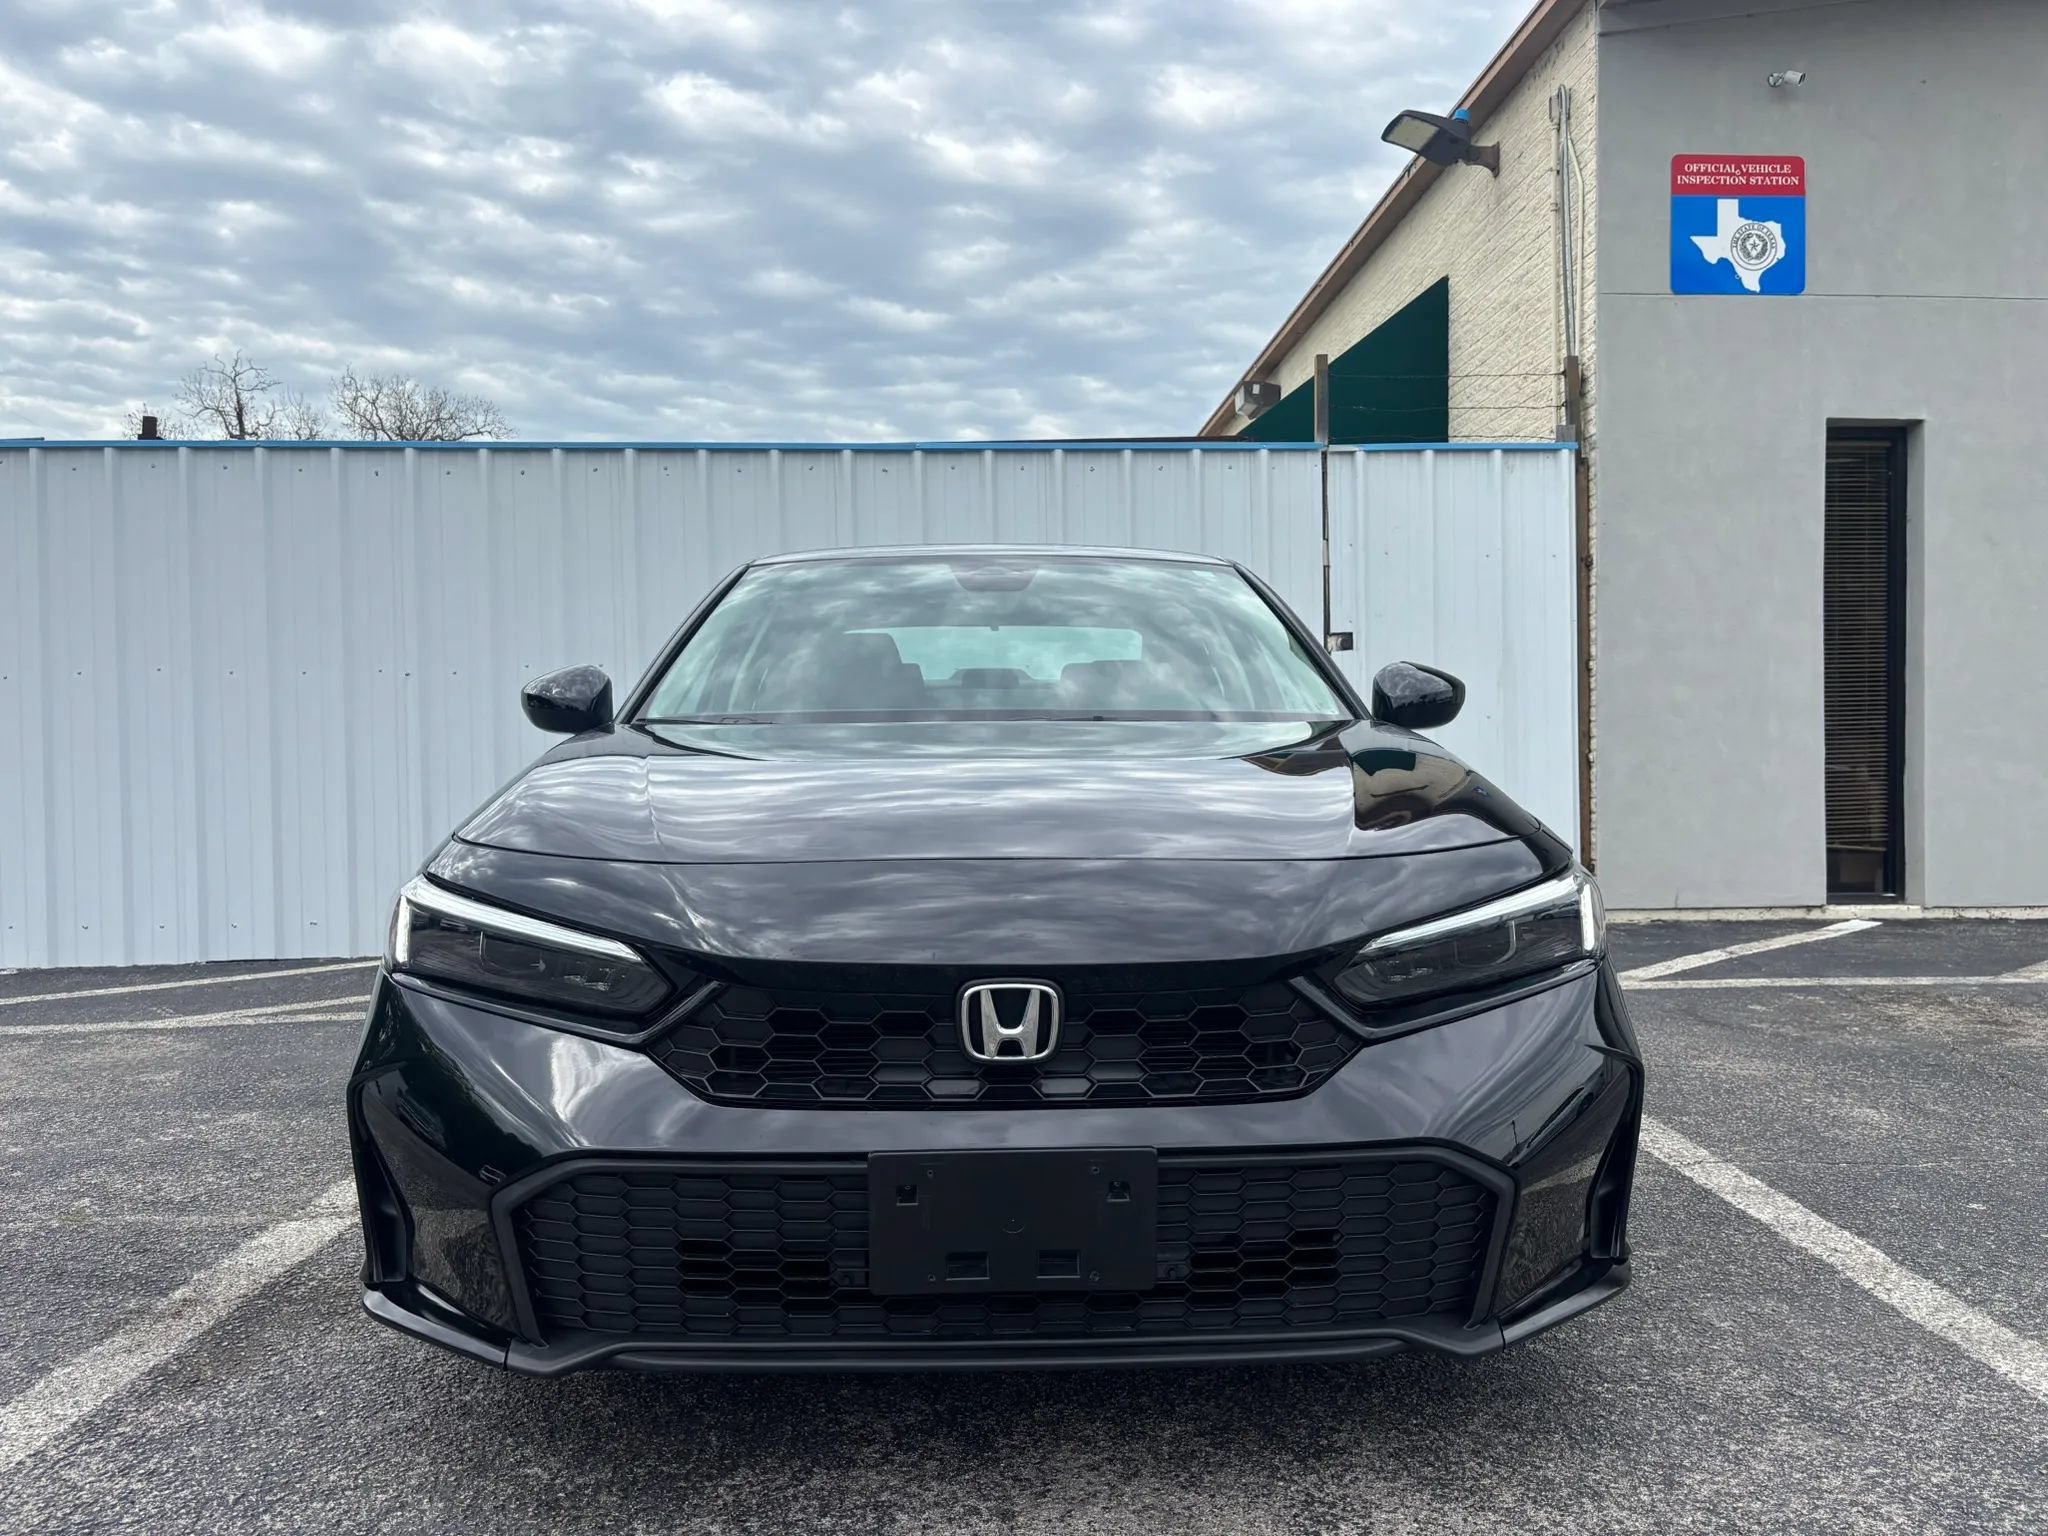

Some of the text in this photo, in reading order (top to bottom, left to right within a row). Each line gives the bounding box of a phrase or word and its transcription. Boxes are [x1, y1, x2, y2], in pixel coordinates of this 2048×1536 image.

[1684, 163, 1792, 174] OFFICIAL VEHICLE
[1677, 175, 1800, 186] INSPECTION STATION
